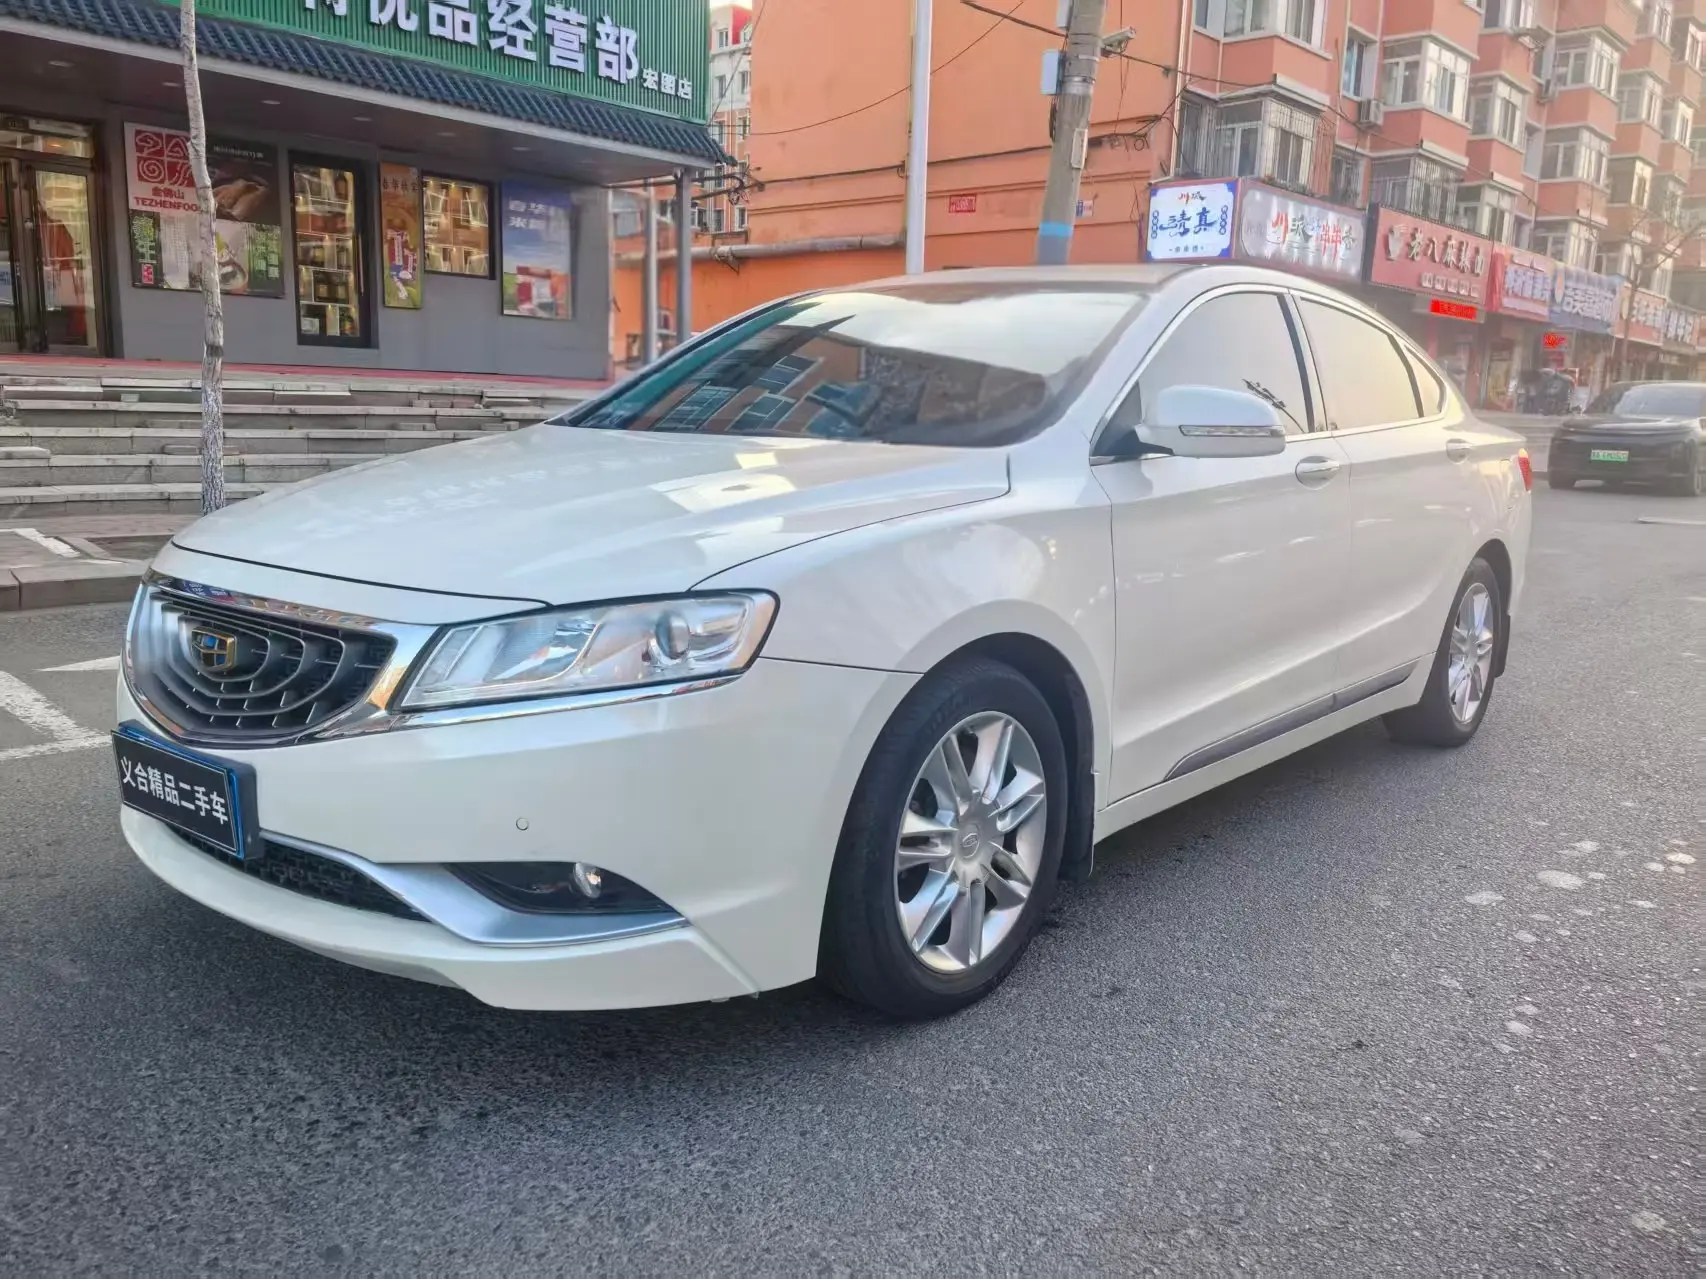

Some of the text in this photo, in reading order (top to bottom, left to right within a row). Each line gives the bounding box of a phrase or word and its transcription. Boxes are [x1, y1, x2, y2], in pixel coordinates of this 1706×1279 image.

[305, 0, 640, 85] 优品经营部
[643, 67, 692, 100] 宏图店
[133, 196, 198, 212] TEZHENFOO
[120, 755, 229, 825] 义合精品二手车
